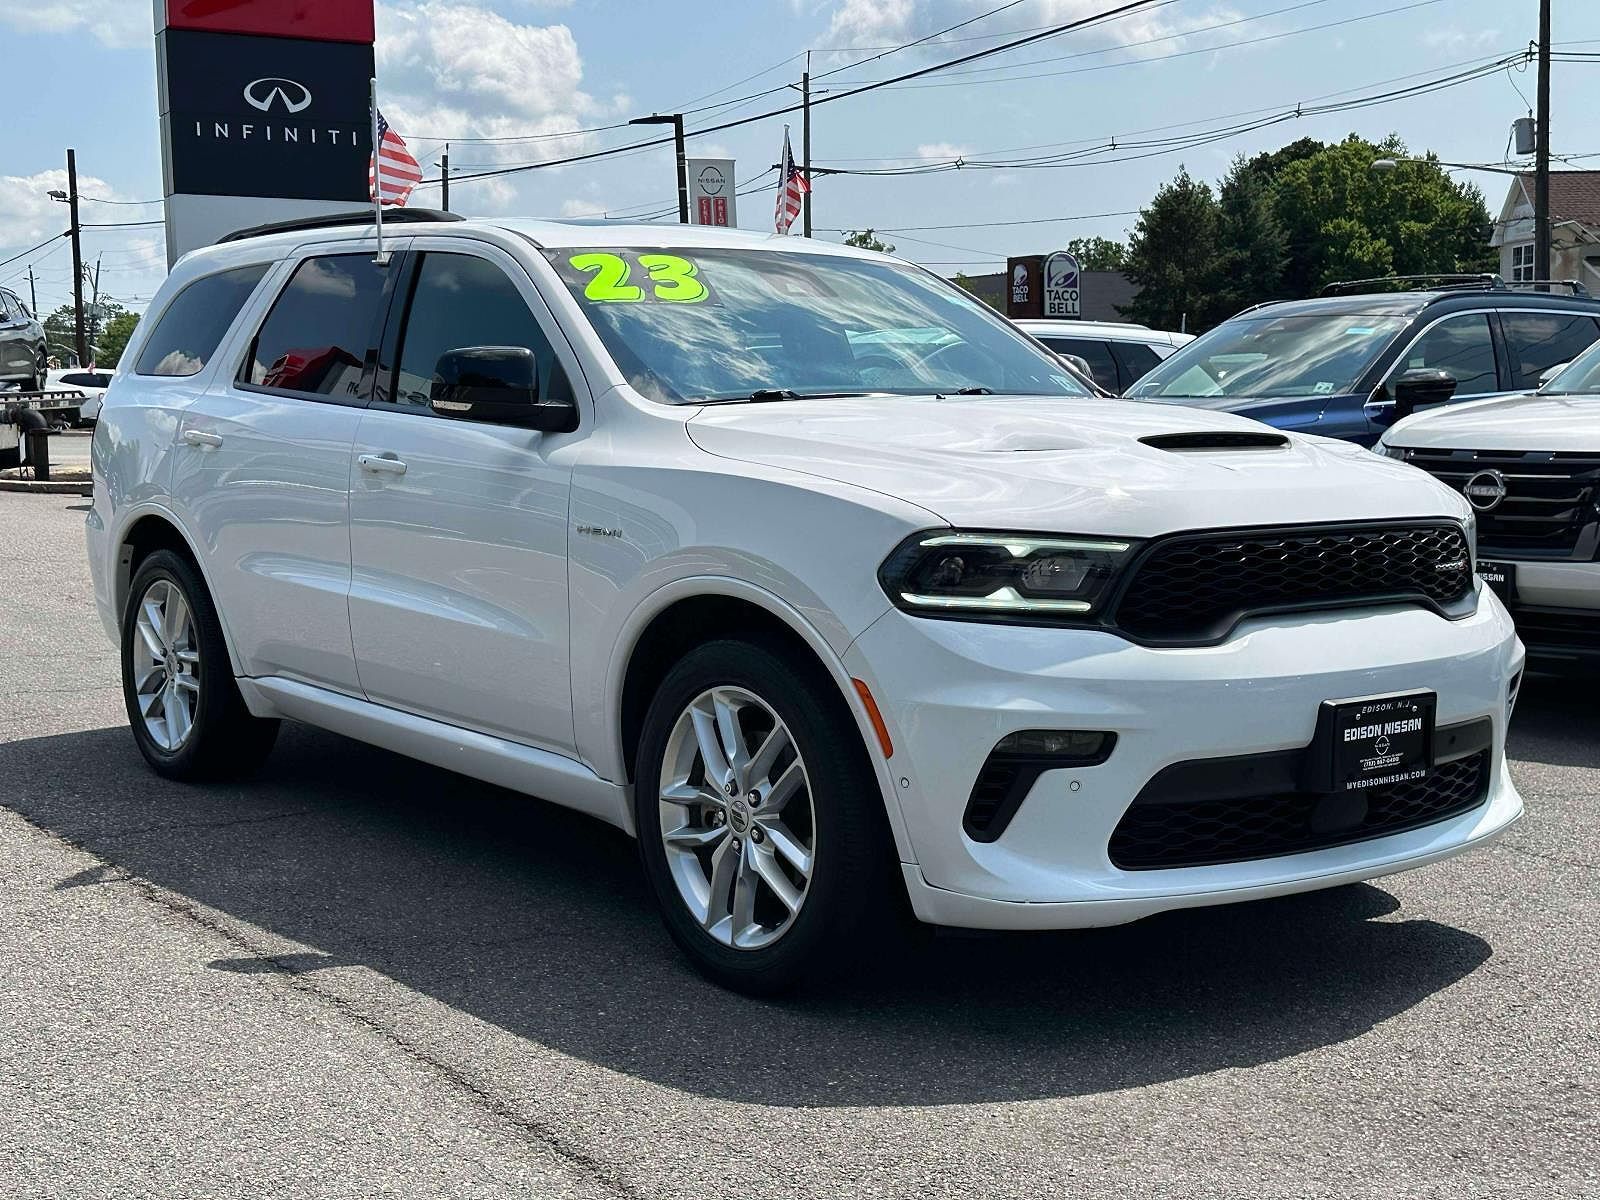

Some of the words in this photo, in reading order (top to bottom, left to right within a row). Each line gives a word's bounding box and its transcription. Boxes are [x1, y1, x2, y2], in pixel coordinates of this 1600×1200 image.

[196, 121, 357, 146] INFINITI
[569, 253, 710, 304] 23
[1012, 286, 1029, 294] TACO
[1046, 289, 1079, 302] TACO
[1013, 293, 1029, 303] BELL
[1049, 302, 1079, 314] BELL
[1479, 572, 1505, 582] ISSAN
[1344, 724, 1382, 742] EDISON
[1384, 717, 1422, 735] NISSAN
[1346, 769, 1426, 790] MYEDISONNISSAN.COM
